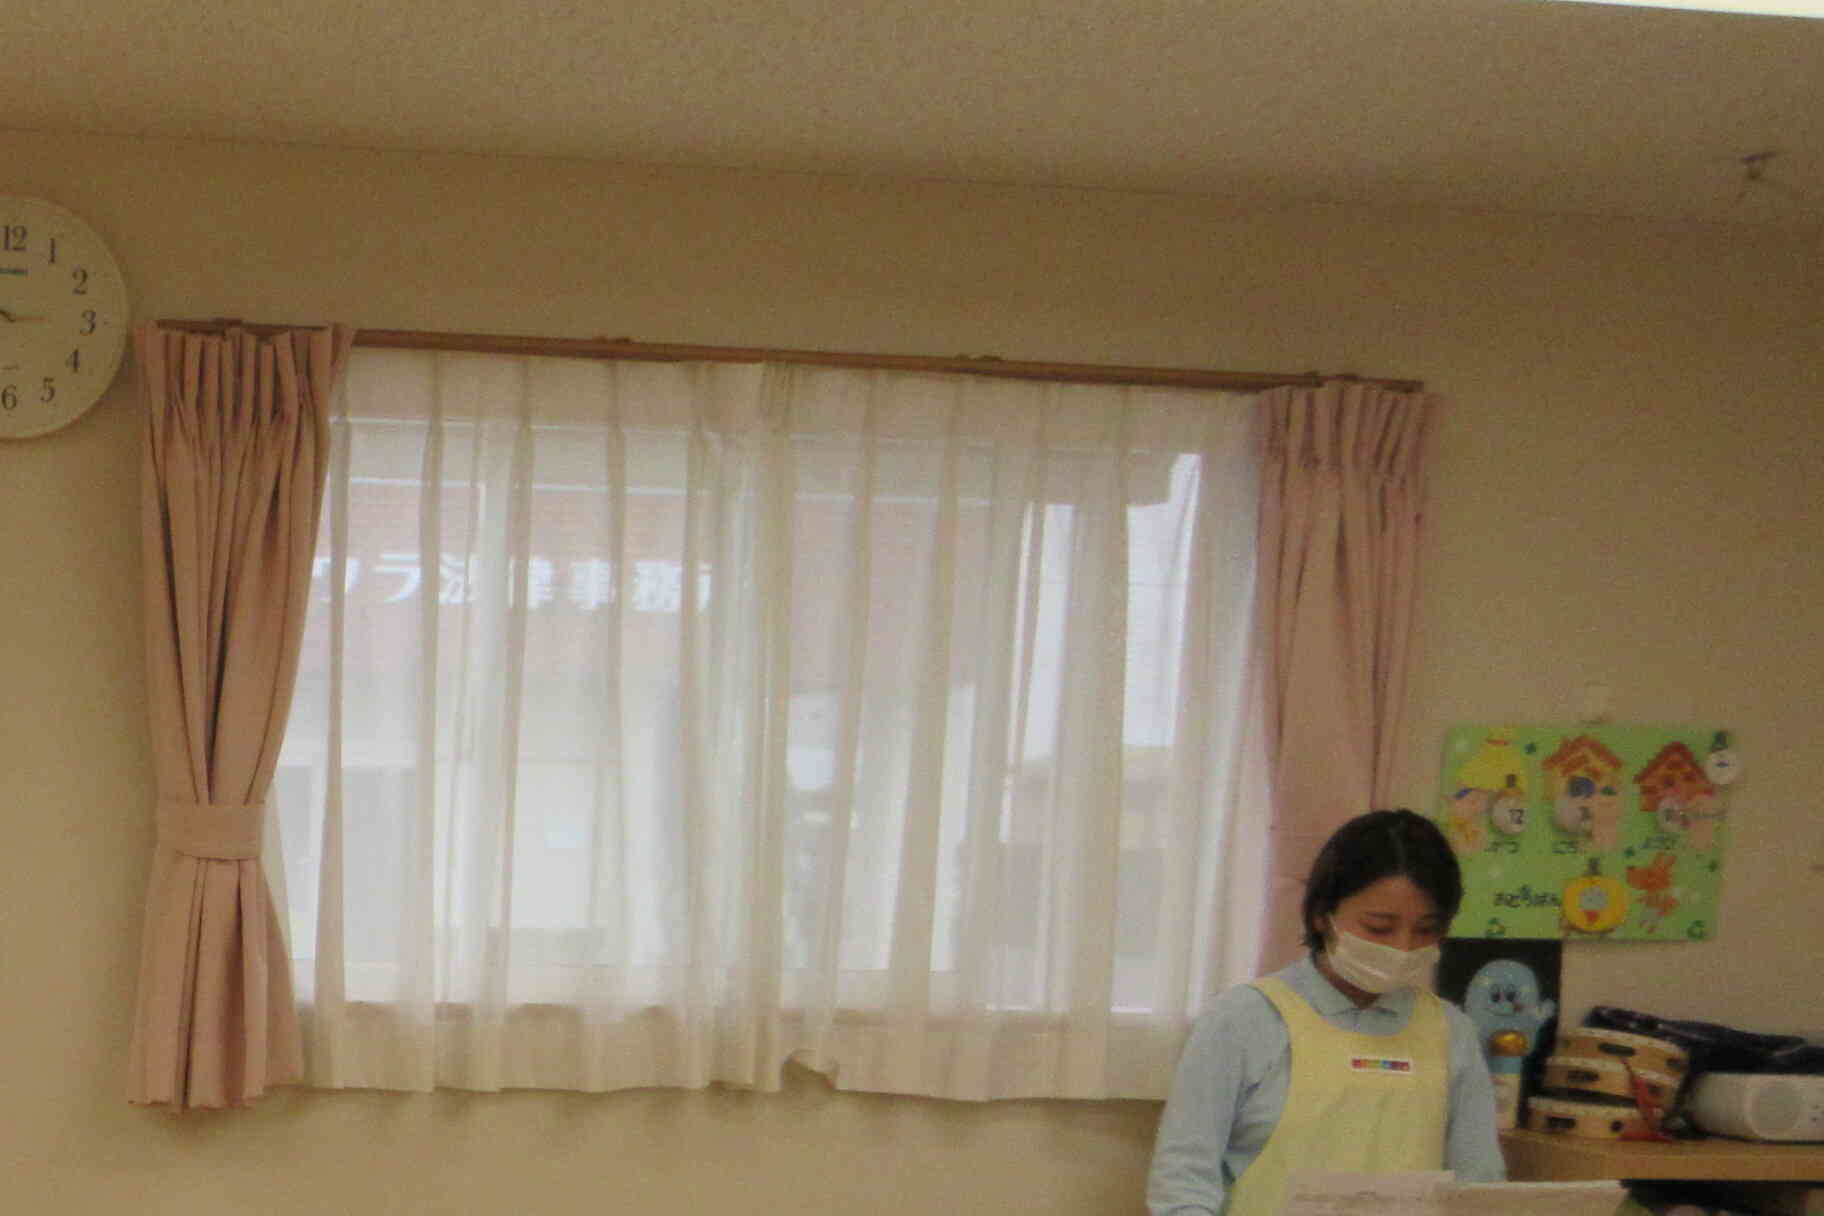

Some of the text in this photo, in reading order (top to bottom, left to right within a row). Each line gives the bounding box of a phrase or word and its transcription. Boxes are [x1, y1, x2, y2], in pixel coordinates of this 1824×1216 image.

[3, 225, 27, 251] 12
[72, 268, 87, 295] 2
[80, 310, 95, 335] 3
[65, 349, 79, 373] 4
[1, 384, 17, 410] 6
[40, 377, 55, 402] 5
